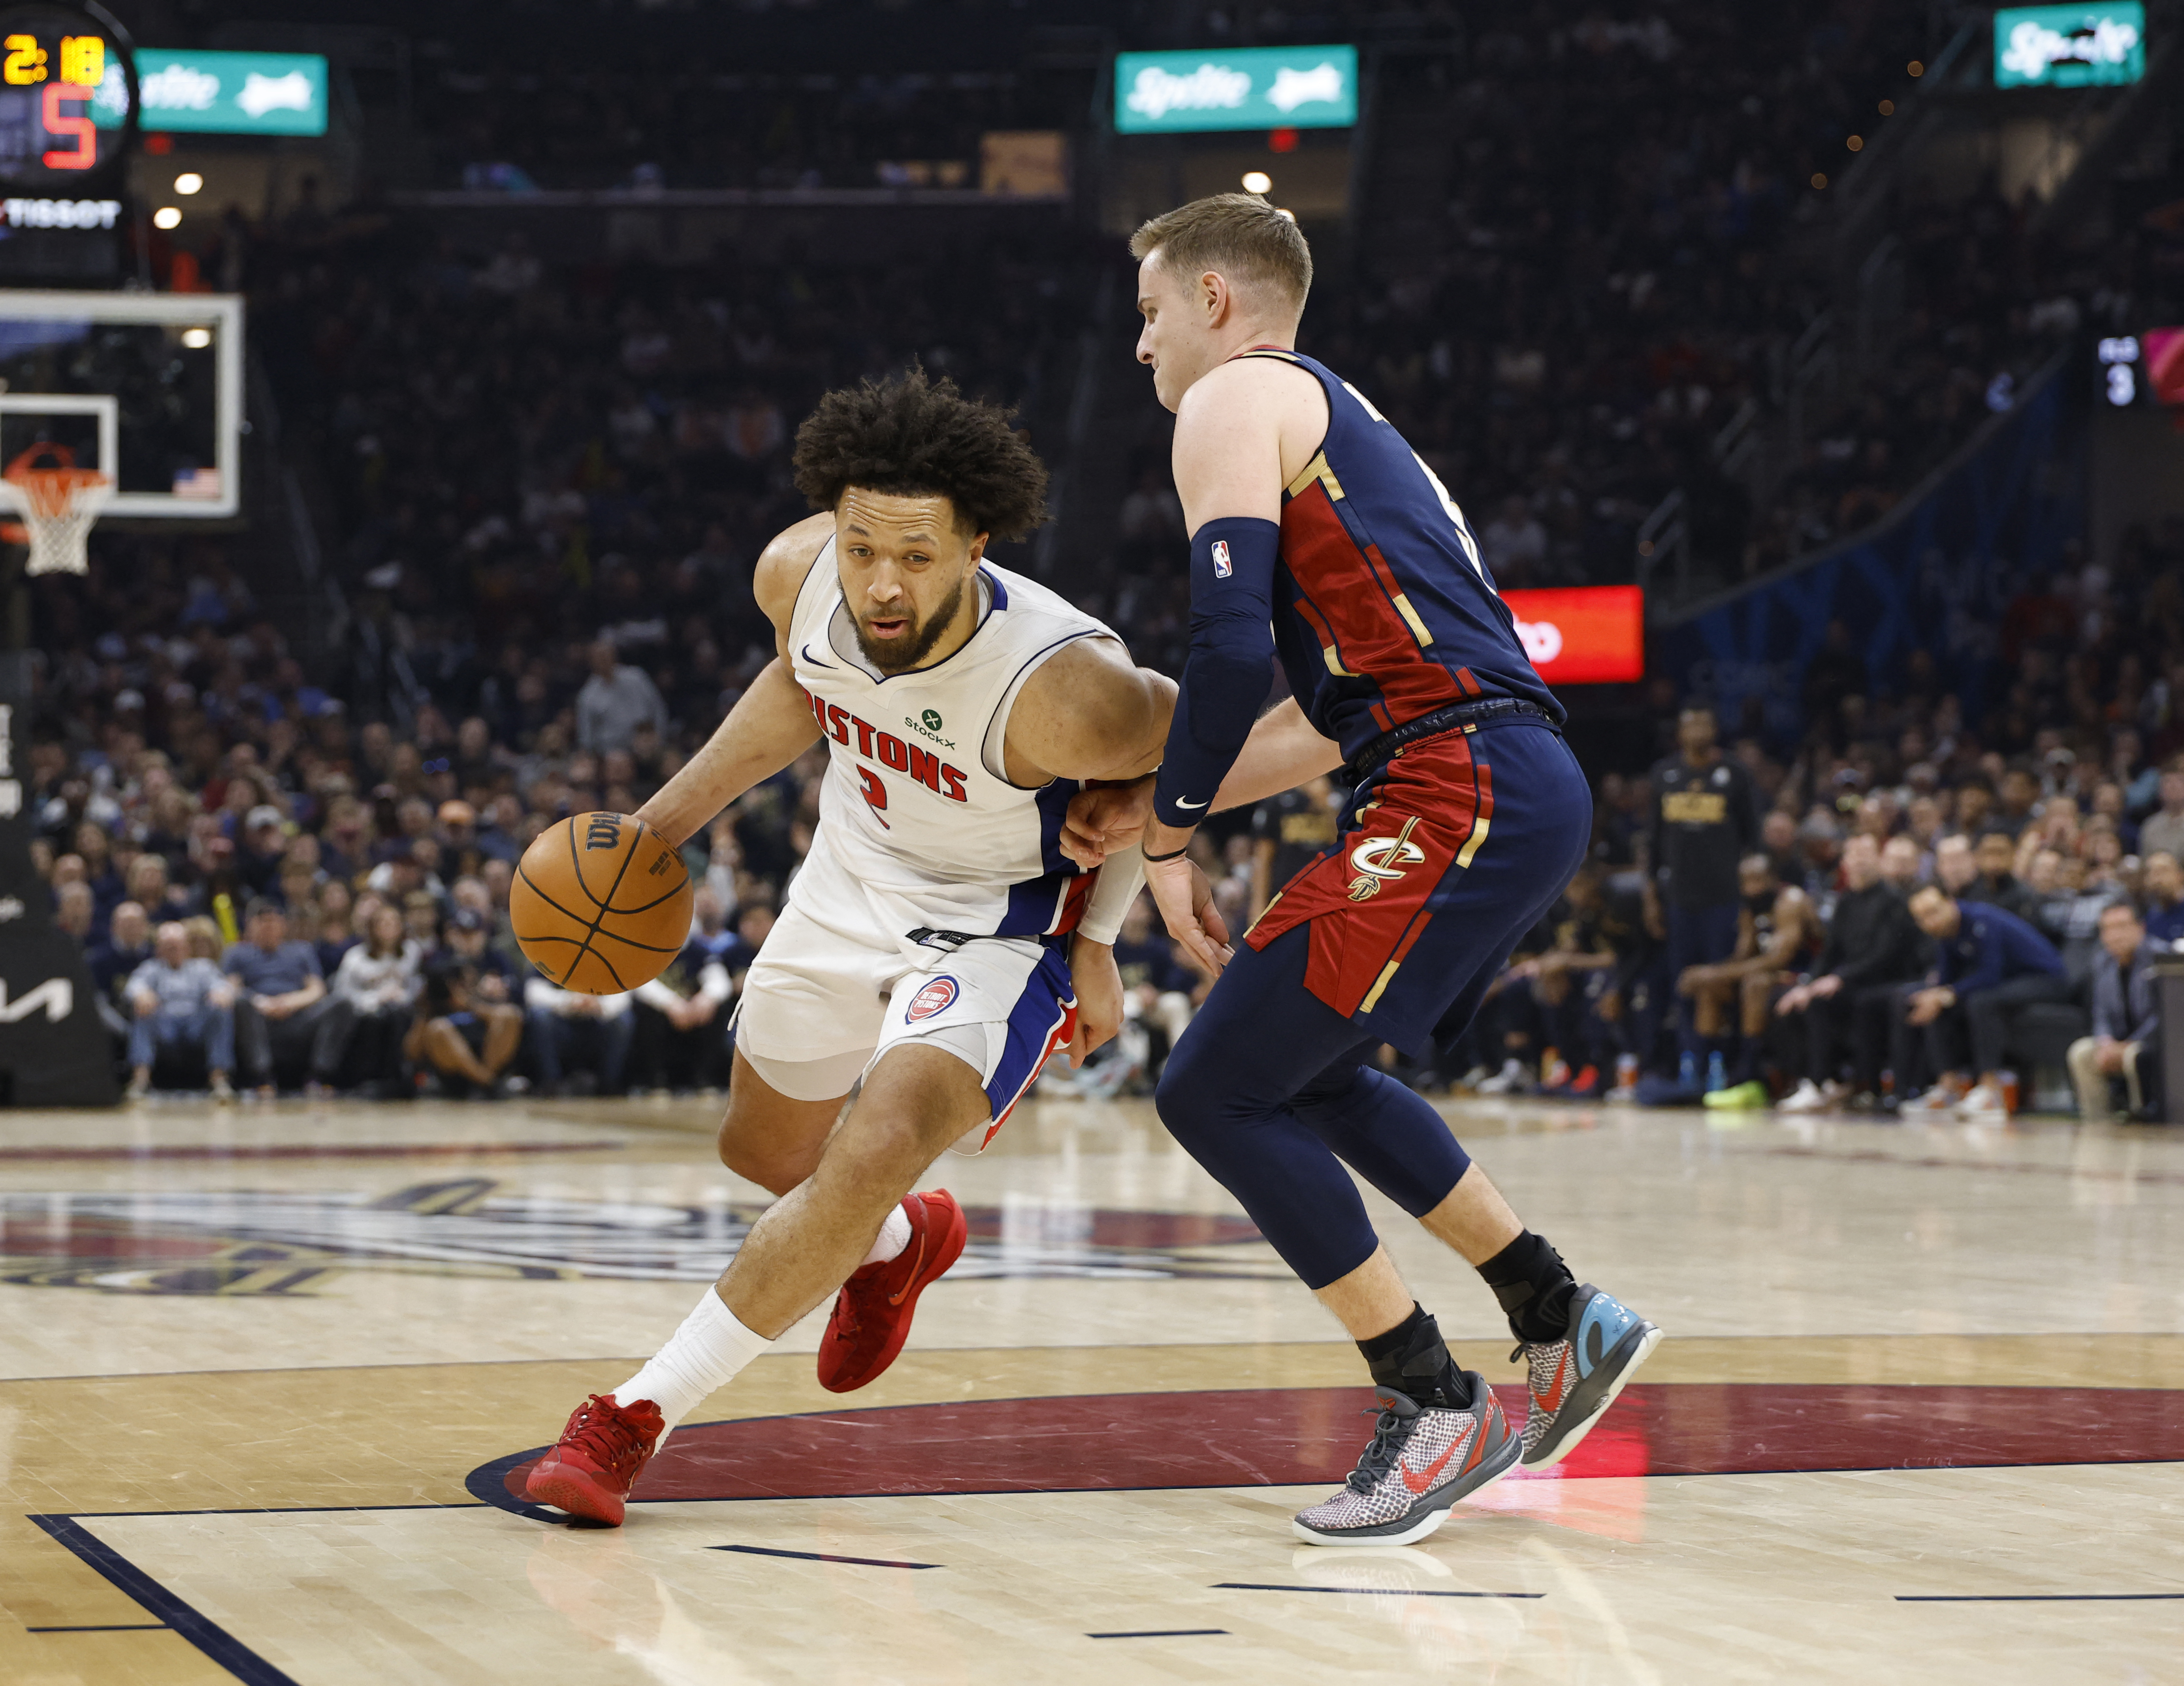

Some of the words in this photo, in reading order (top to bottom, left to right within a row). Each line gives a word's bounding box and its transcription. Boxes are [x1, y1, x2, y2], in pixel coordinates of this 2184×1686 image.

[4, 34, 105, 86] 2:18
[42, 82, 96, 169] 5
[5, 198, 122, 229] TISSOT
[904, 717, 956, 751] StockX
[914, 1000, 941, 1009] PISTONS
[921, 992, 948, 1001] DETROIT
